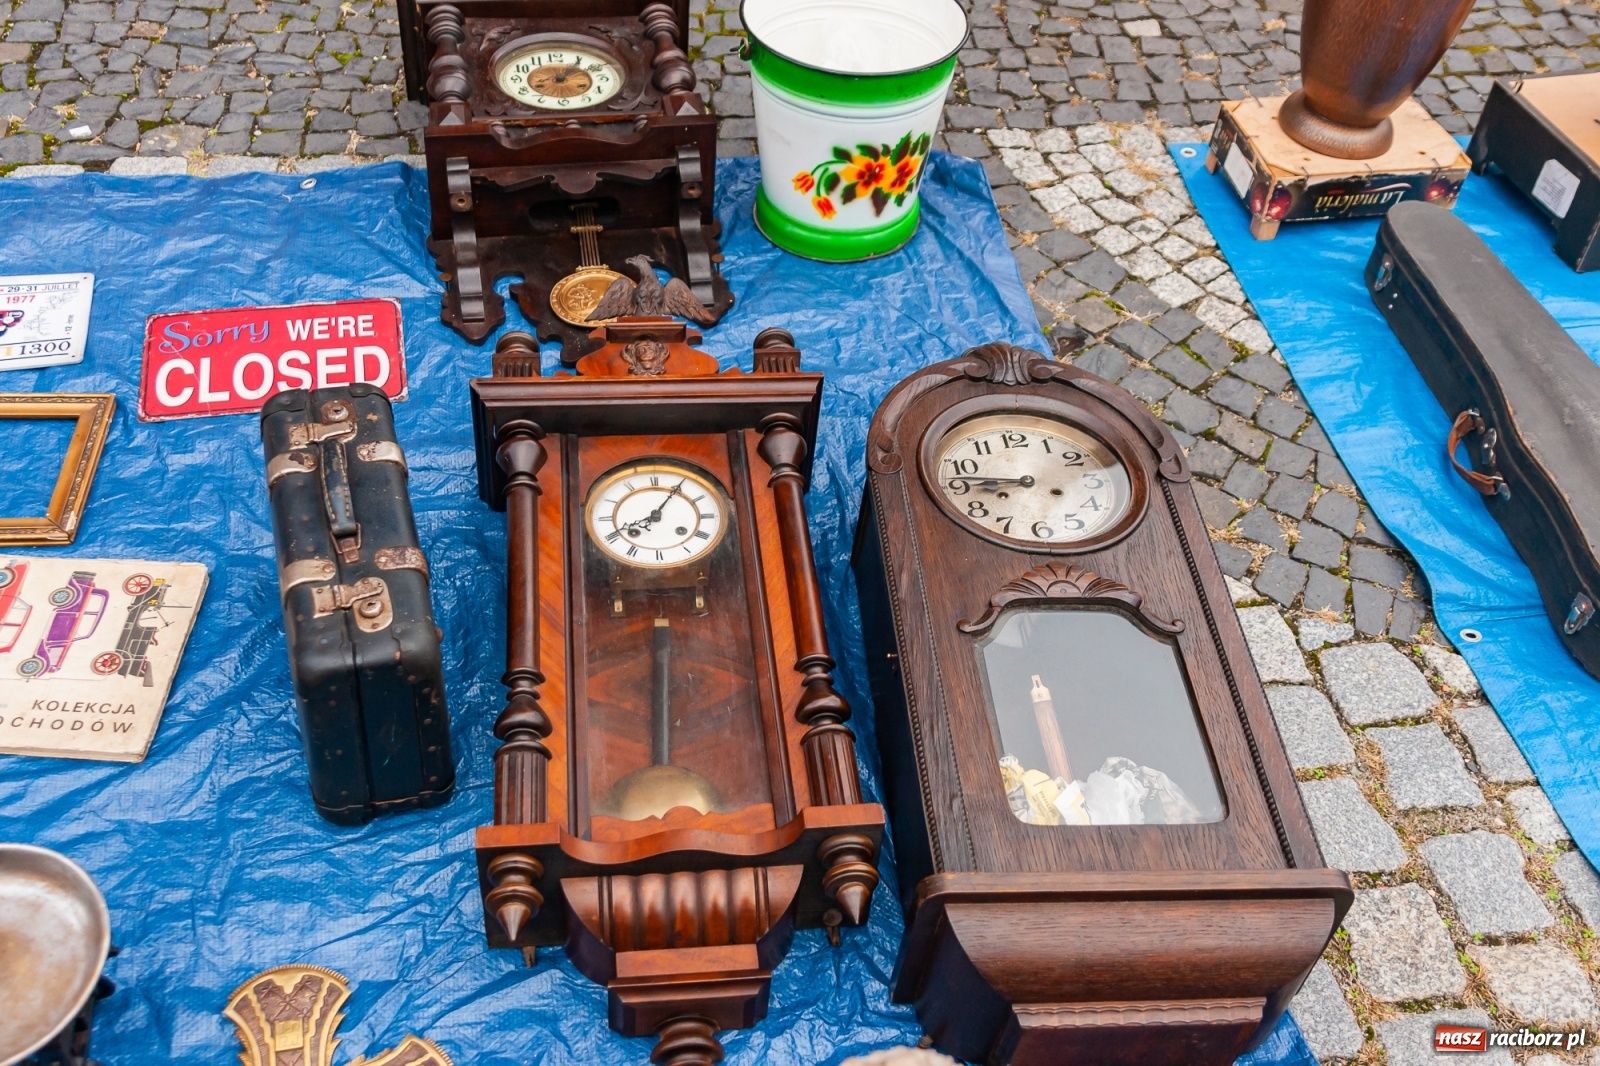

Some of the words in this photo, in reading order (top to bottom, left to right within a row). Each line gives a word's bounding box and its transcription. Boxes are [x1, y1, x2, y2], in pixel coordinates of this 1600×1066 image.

[6, 295, 36, 304] 1977
[158, 318, 270, 354] Sorry
[286, 314, 375, 342] WE'RE
[18, 340, 71, 356] 1300
[155, 345, 391, 407] CLOSED
[973, 440, 993, 456] 11
[1001, 433, 1029, 449] 12
[1041, 438, 1052, 454] 1
[951, 458, 979, 476] 10
[1062, 451, 1085, 467] 2
[948, 479, 971, 496] 9
[1082, 473, 1104, 490] 3
[967, 501, 990, 518] 8
[1080, 495, 1102, 512] 4
[995, 516, 1014, 534] 7
[1031, 521, 1054, 539] 6
[1064, 513, 1086, 530] 5
[32, 700, 136, 715] KOLEKCJA
